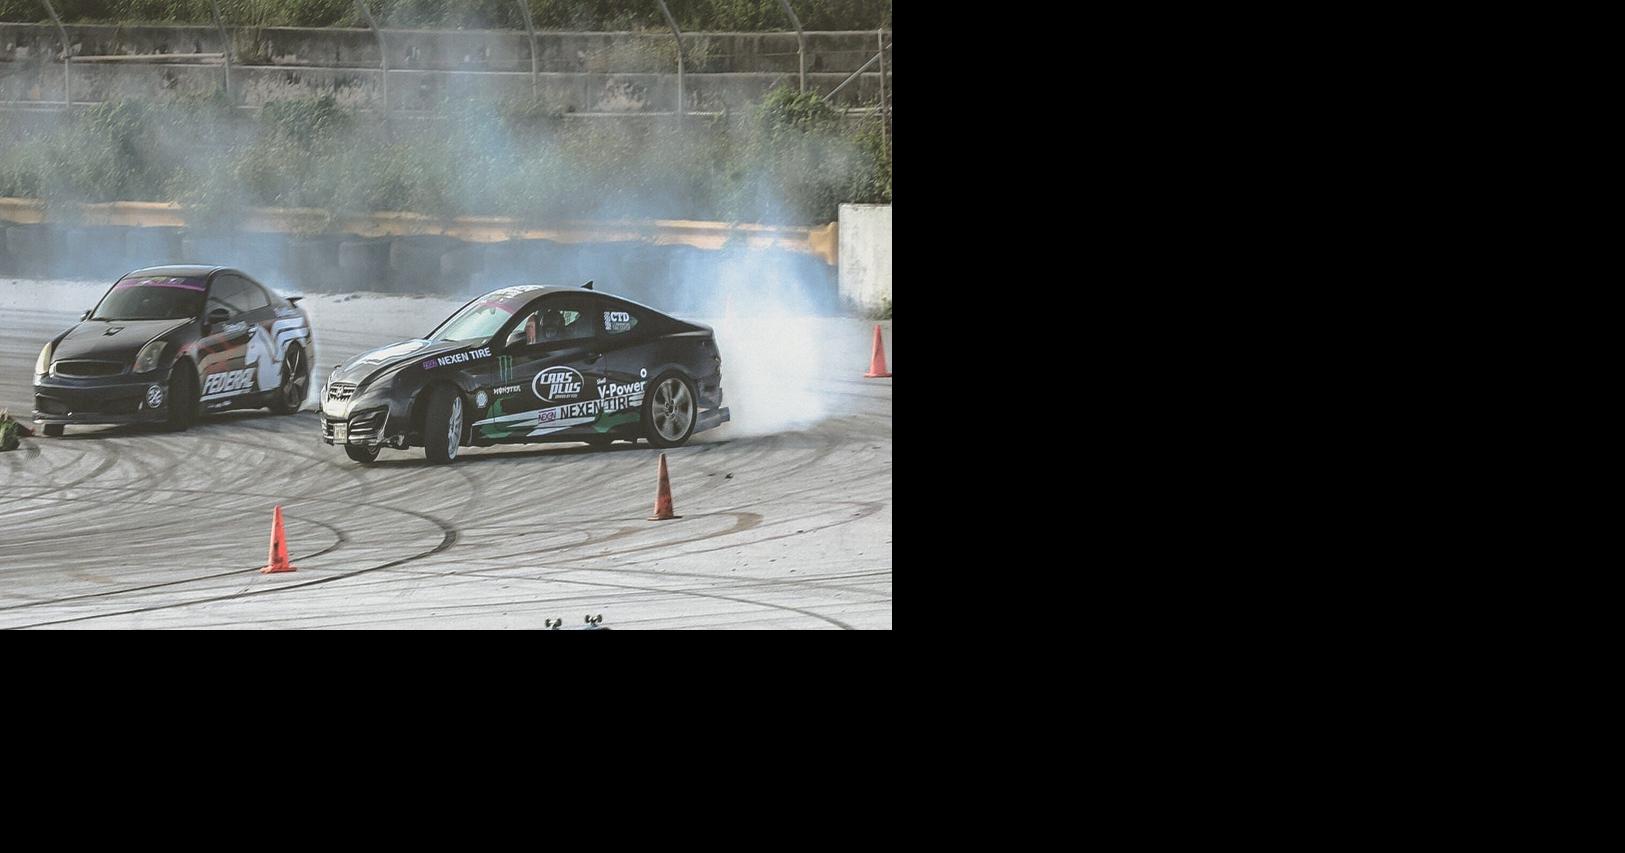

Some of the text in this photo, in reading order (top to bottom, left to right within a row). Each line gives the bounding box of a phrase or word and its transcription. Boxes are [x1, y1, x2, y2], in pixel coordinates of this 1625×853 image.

[610, 311, 630, 322] CTD
[437, 352, 469, 366] NEXEN
[469, 347, 492, 360] TIRE
[202, 367, 257, 396] FEDERAL
[493, 385, 521, 395] MONSTER
[597, 380, 648, 399] V-Power
[560, 399, 601, 420] NEXEN
